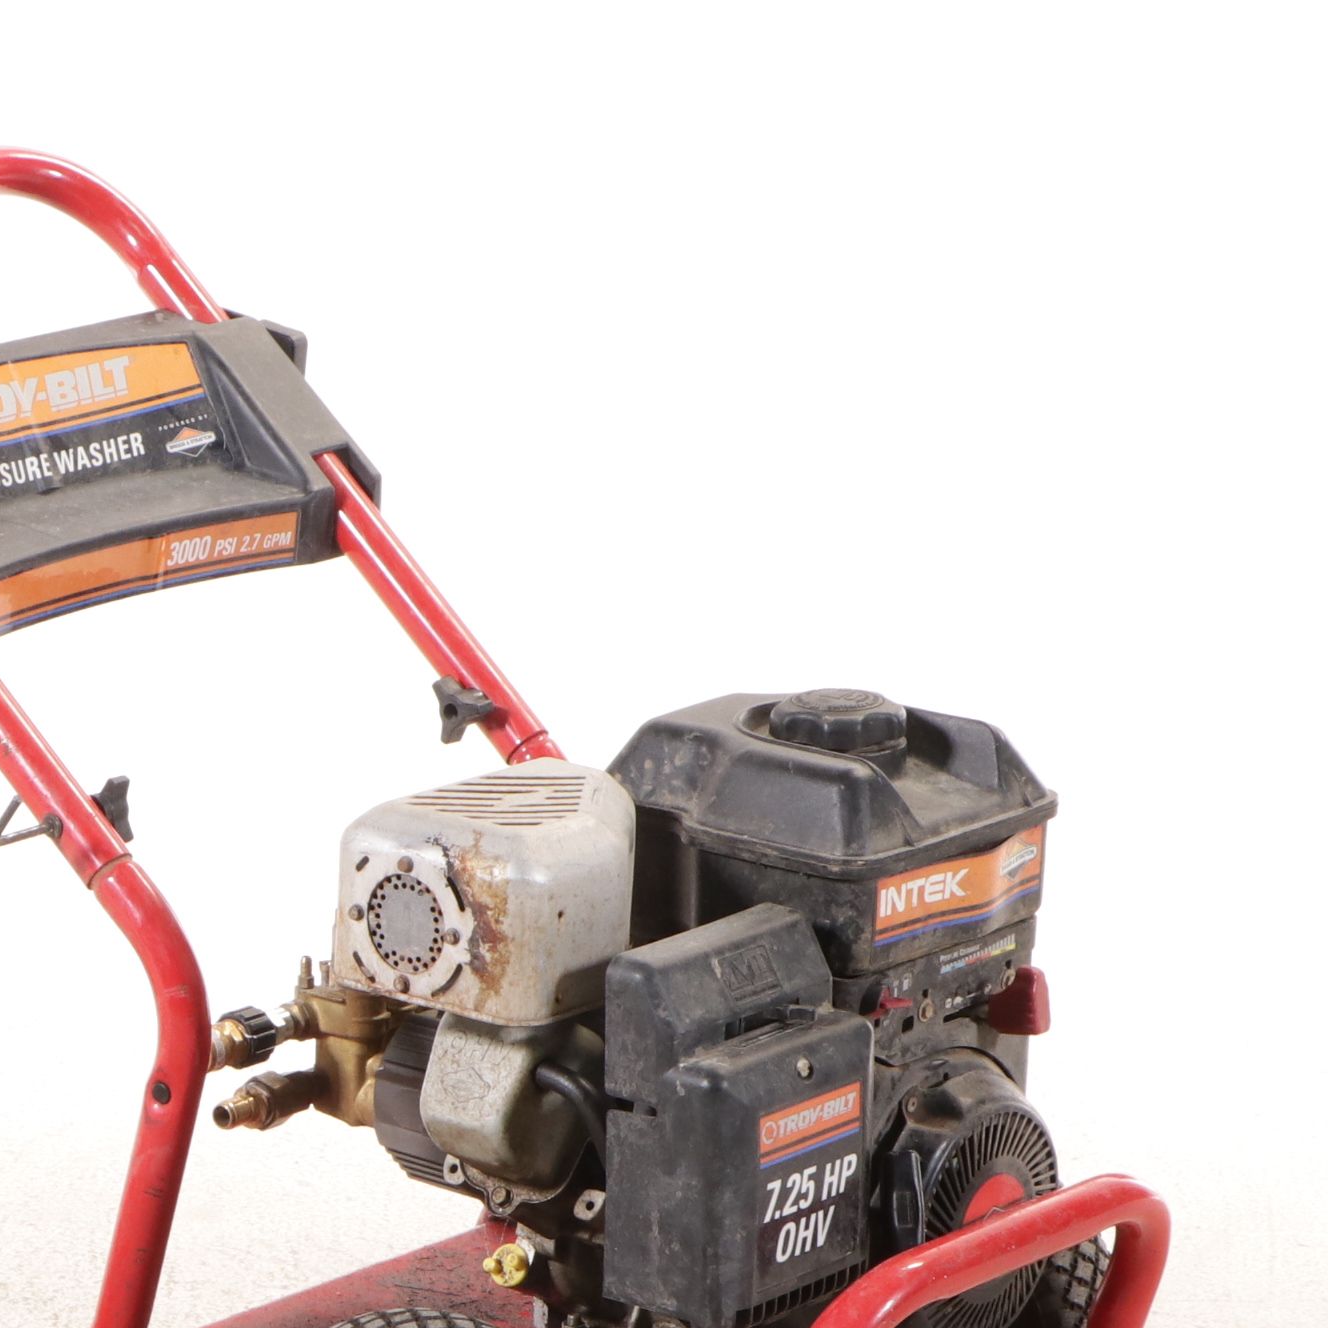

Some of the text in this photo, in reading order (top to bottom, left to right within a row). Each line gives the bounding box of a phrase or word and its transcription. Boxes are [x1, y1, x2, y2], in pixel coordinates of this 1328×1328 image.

[53, 432, 146, 475] WASHER
[167, 531, 292, 567] 3000 PSI 2.7 GPM
[879, 868, 969, 918] INTEK
[777, 1092, 857, 1138] TROY-BILT
[763, 1152, 858, 1224] 7.25 HP
[775, 1204, 835, 1264] OHV
